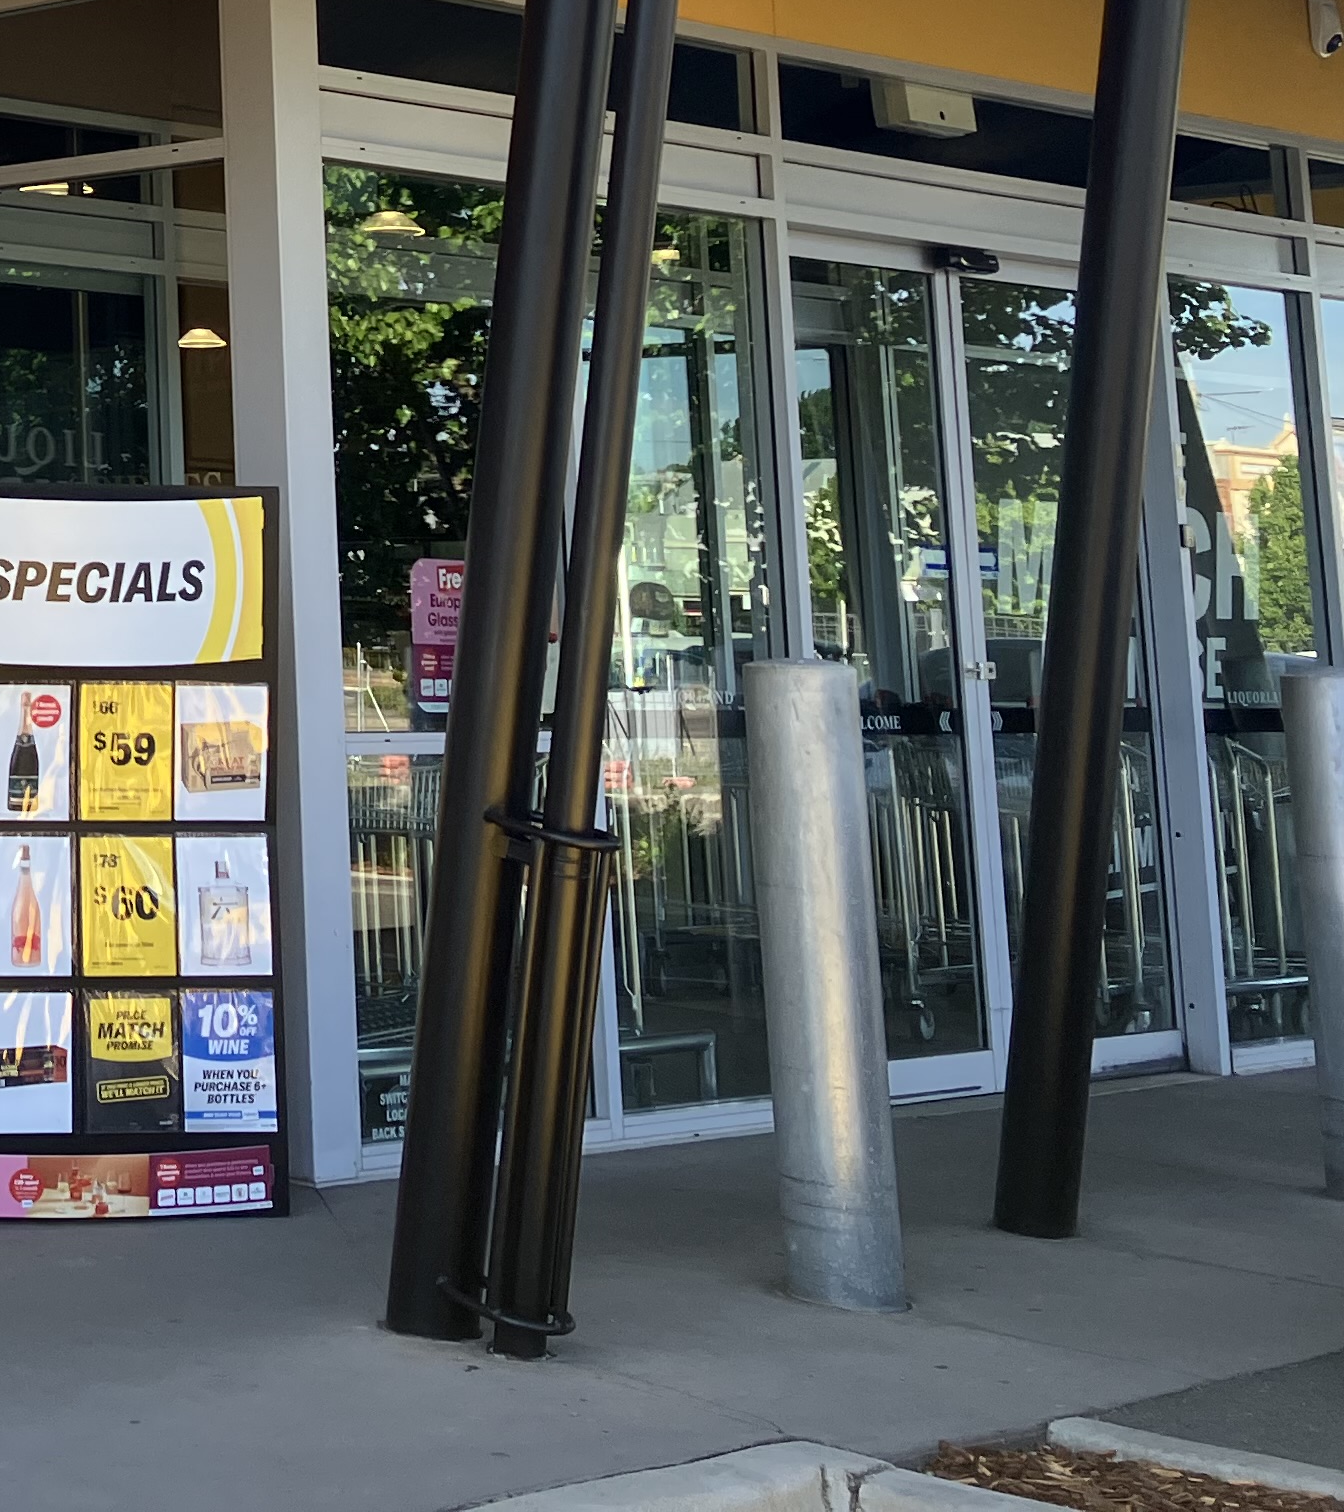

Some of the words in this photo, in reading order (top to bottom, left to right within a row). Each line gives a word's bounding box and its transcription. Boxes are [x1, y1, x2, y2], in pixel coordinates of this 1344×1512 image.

[430, 593, 461, 611] Europ
[428, 612, 458, 627] Glass
[1227, 691, 1280, 707] LIQUORLA
[861, 715, 902, 730] LCOME
[94, 731, 156, 767] $59
[198, 1003, 258, 1038] 10%
[97, 1021, 165, 1040] MATCH
[240, 1027, 258, 1036] OFF
[208, 1039, 249, 1055] WINE
[202, 1069, 234, 1080] WHEN
[237, 1069, 259, 1080] YOU
[193, 1081, 251, 1092] PURCHASE
[254, 1082, 267, 1091] 6+
[207, 1093, 255, 1104] BOTTLES
[380, 1092, 408, 1106] SWITC
[372, 1126, 397, 1140] BACK
